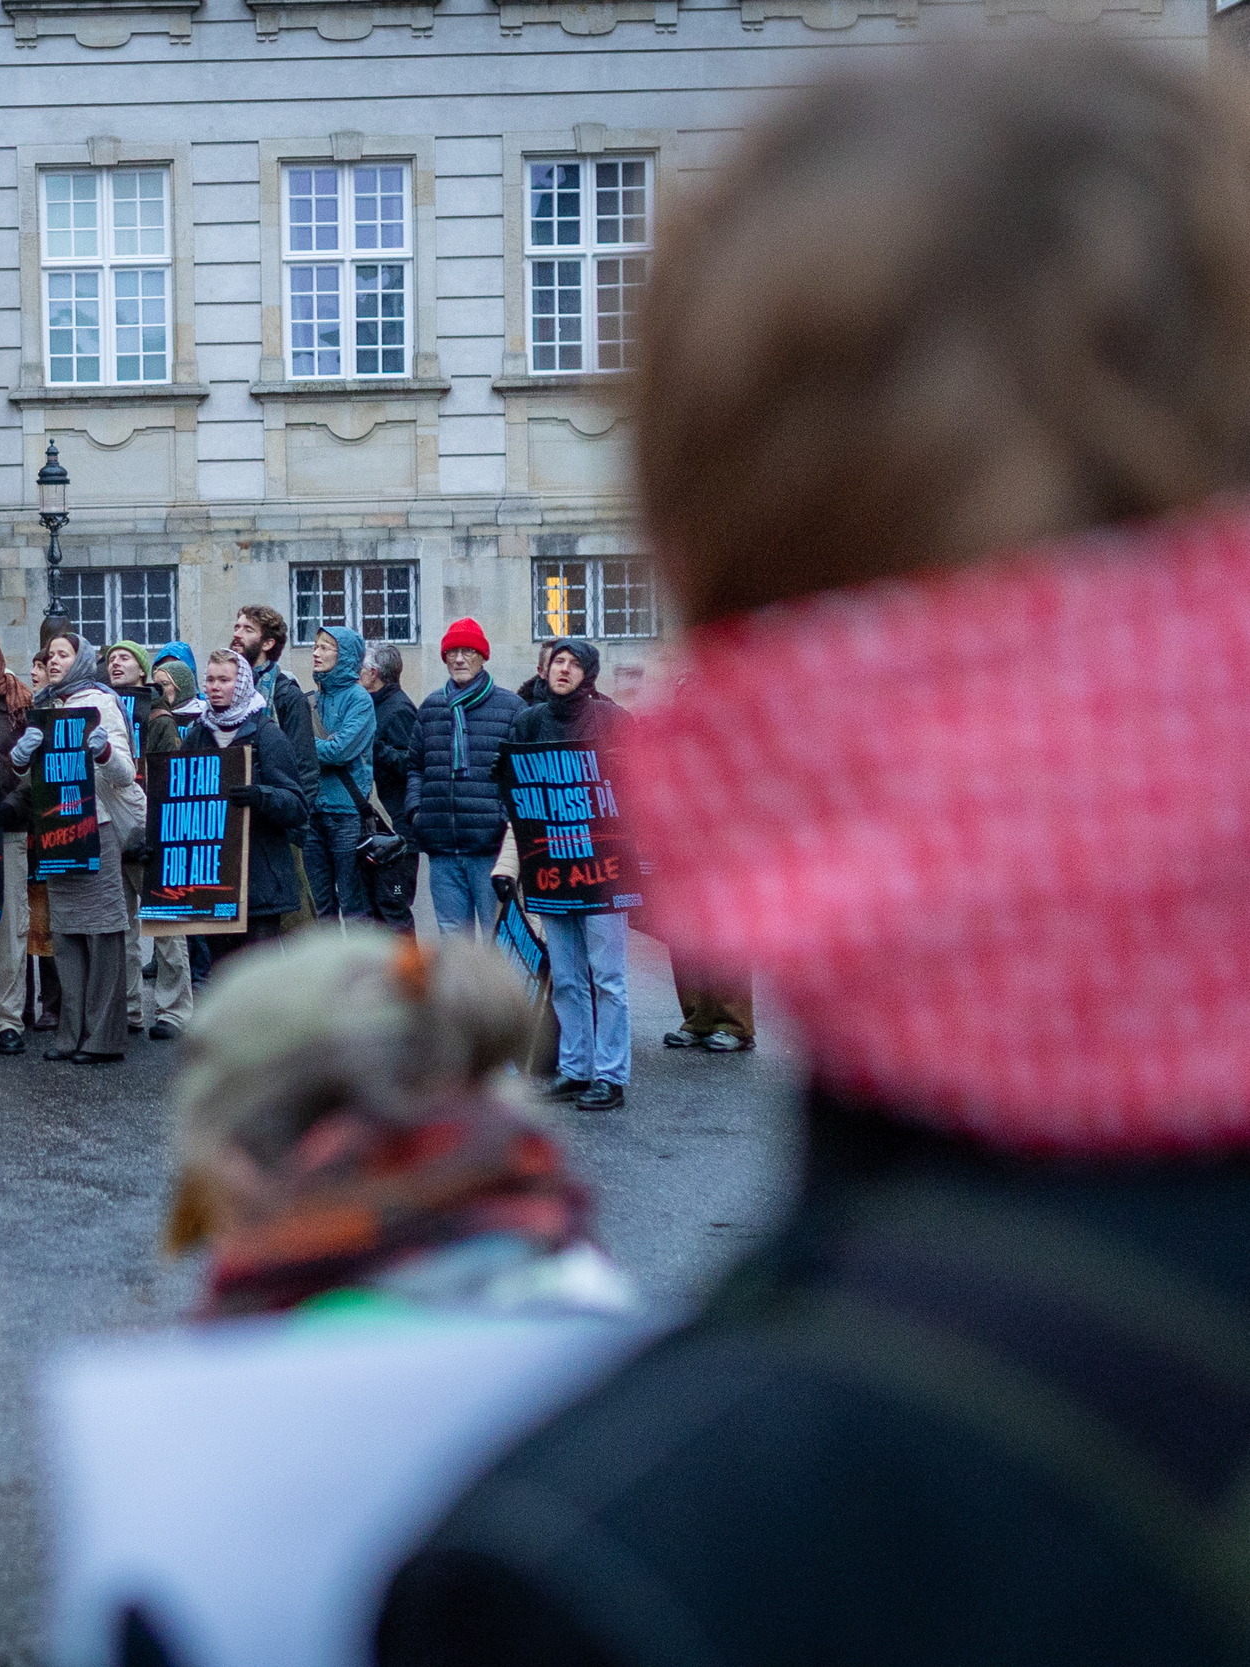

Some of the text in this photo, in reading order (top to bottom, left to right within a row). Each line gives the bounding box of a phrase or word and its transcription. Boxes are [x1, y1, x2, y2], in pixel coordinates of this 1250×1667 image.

[54, 719, 66, 749] EN
[169, 755, 221, 798] EN FAIR
[510, 750, 601, 784] KLIMALOVEN
[511, 779, 620, 822] SKAL PASSE PÅ
[41, 824, 76, 850] VORES
[160, 800, 228, 843] KLIMALOV
[546, 824, 594, 859] ELITEN
[162, 845, 222, 887] FOR ALLE
[536, 867, 561, 891] OS
[568, 855, 621, 888] ALLE
